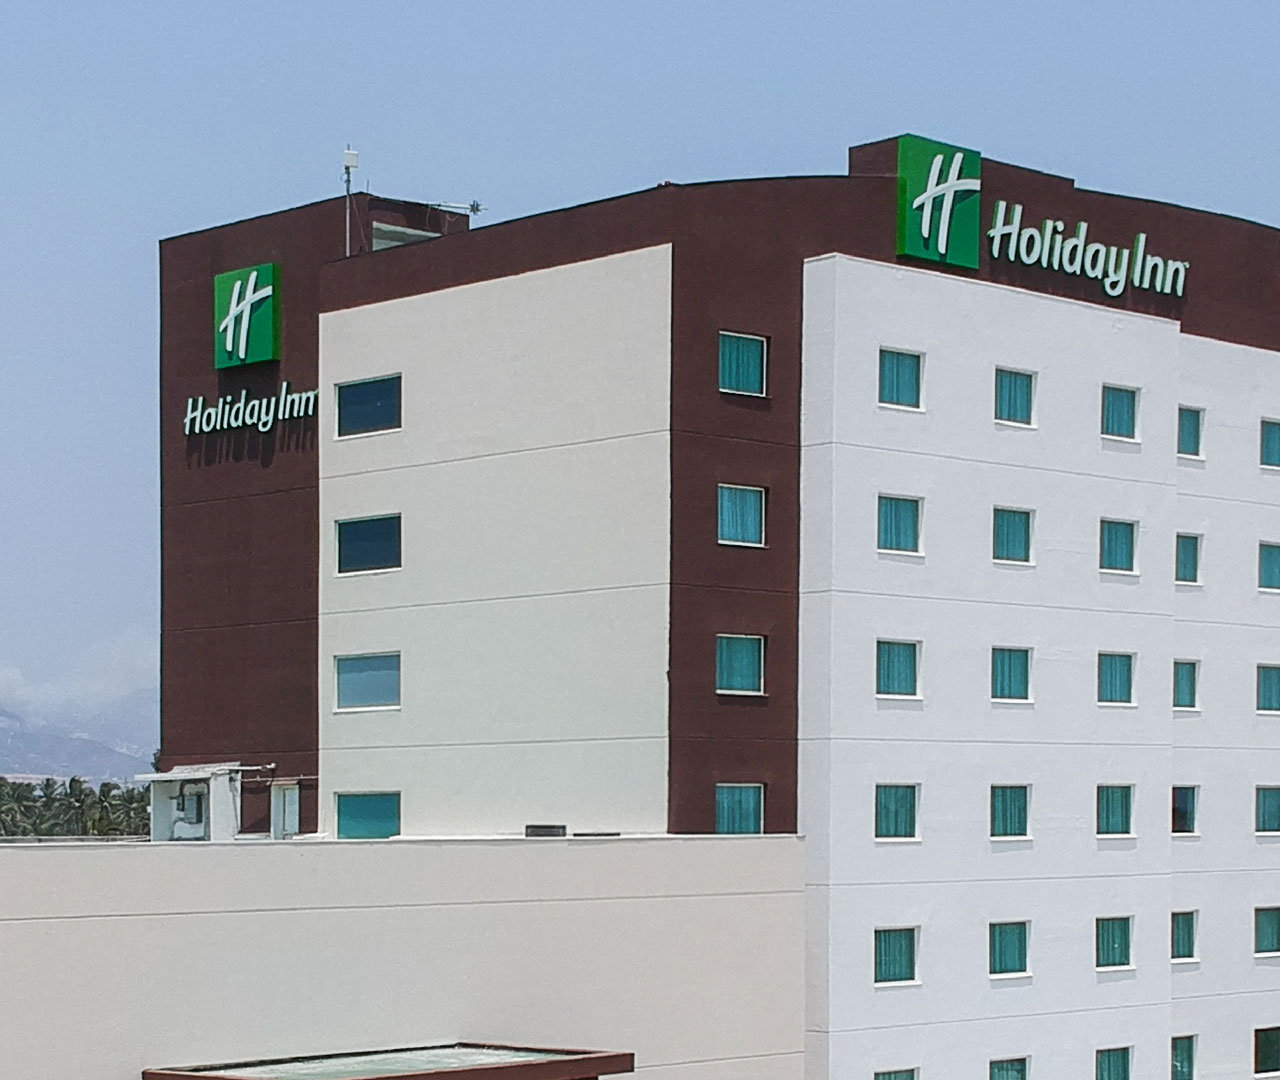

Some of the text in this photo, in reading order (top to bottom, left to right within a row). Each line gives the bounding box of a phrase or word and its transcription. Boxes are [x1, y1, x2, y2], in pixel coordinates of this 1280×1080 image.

[913, 152, 981, 254] H
[987, 200, 1188, 297] Holiday Inn
[219, 271, 273, 359] H
[183, 381, 315, 435] Holiday Inn
